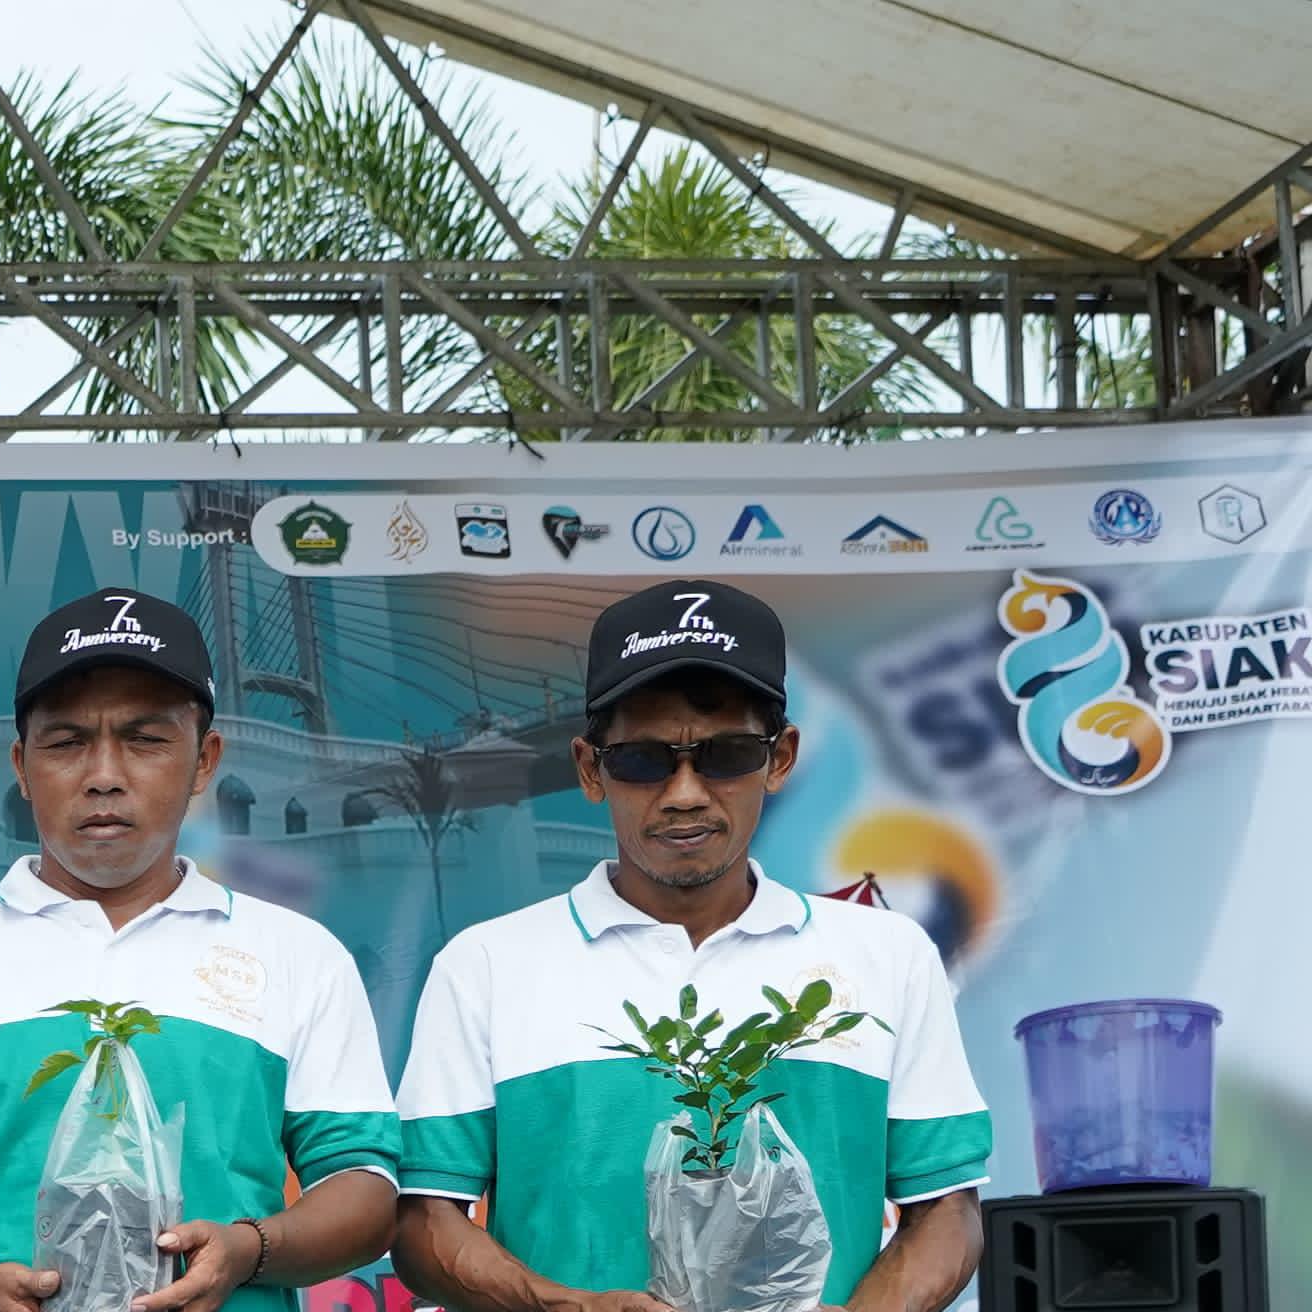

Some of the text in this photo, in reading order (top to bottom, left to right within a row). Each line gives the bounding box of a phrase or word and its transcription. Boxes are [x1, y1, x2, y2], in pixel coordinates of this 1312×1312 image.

[112, 528, 140, 550] By
[146, 528, 235, 550] Support
[1148, 614, 1308, 646] KABUPATEN
[1153, 636, 1312, 695] SIAK
[1164, 696, 1226, 712] MENUJU
[1231, 690, 1267, 705] SIAK
[1172, 713, 1204, 727] DAN
